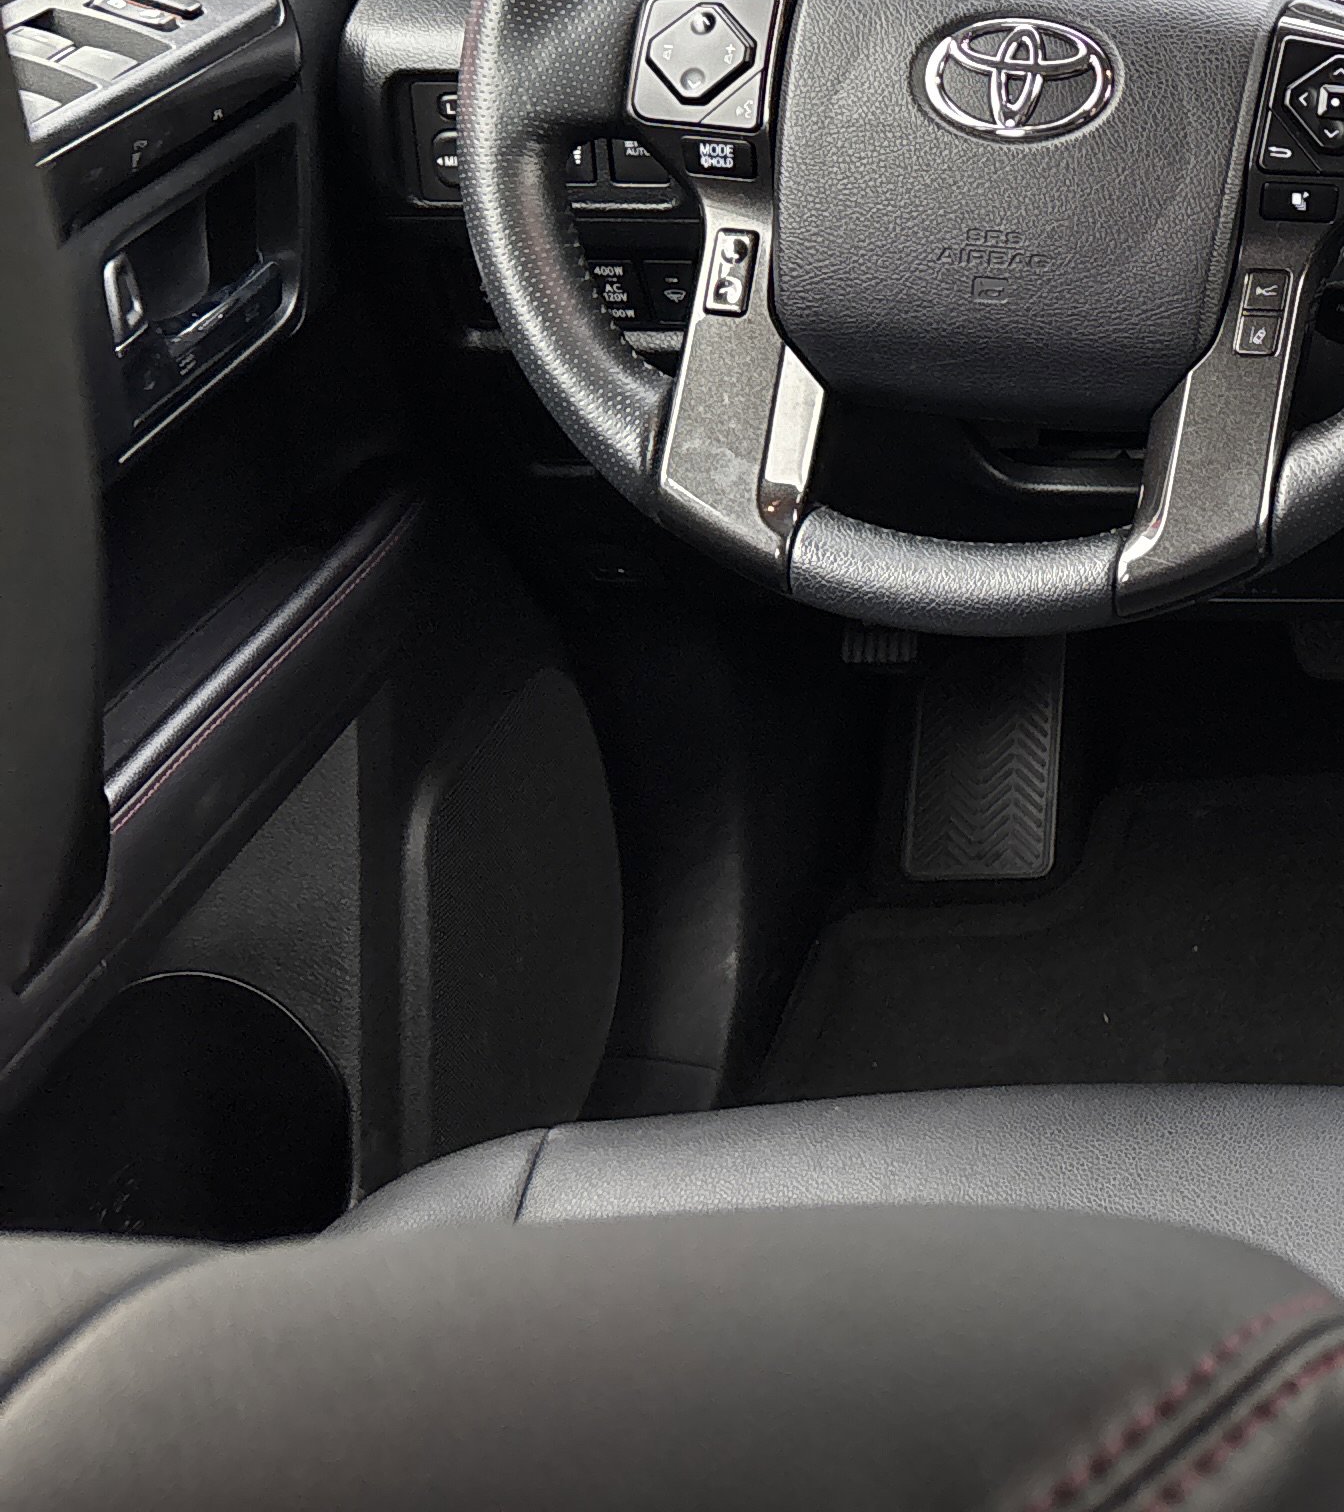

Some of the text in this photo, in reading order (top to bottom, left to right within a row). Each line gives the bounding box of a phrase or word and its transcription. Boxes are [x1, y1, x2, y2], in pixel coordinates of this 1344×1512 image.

[445, 102, 457, 115] L
[700, 143, 735, 157] MODE
[710, 158, 734, 168] HOLD
[965, 228, 1023, 246] SRS
[936, 247, 1052, 268] AIRBAG
[594, 266, 624, 276] 400W
[605, 284, 623, 293] AC
[603, 292, 628, 302] 120V
[609, 309, 635, 318] 00W
